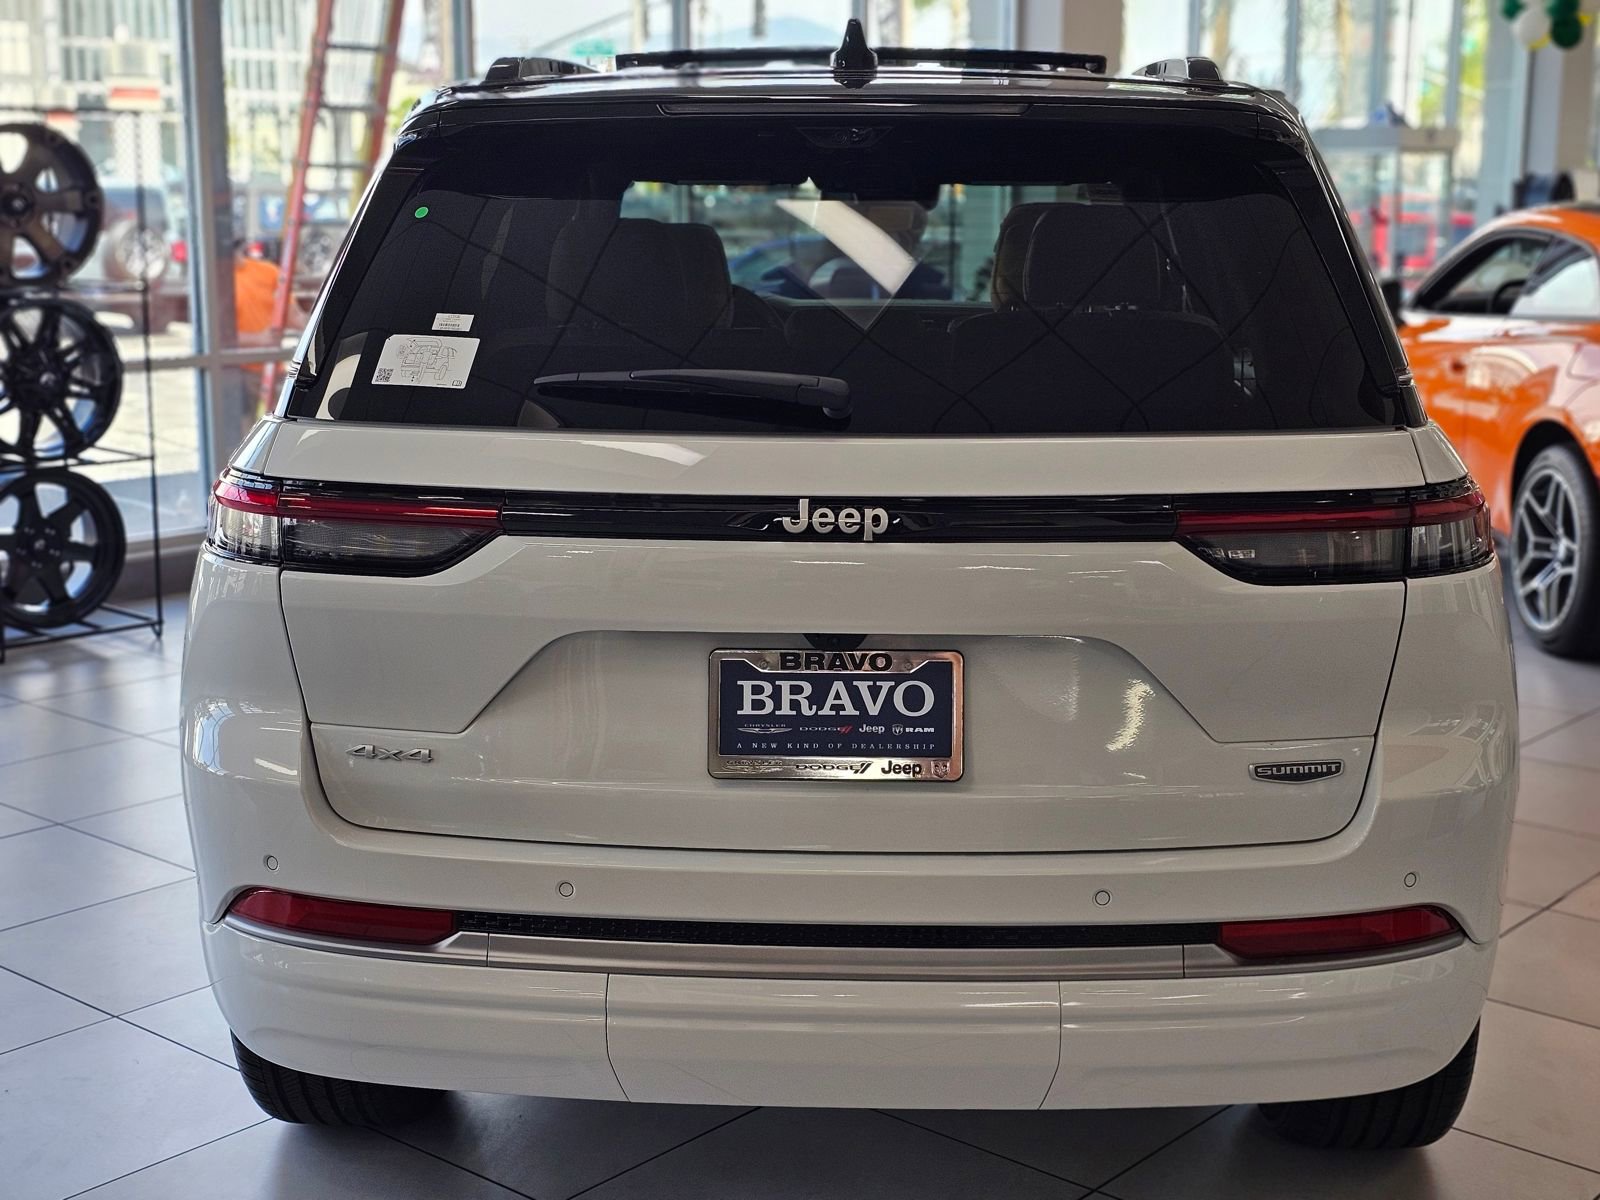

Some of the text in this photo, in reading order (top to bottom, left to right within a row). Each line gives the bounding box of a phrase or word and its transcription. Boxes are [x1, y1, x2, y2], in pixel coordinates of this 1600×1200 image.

[782, 498, 889, 541] Jeep
[780, 652, 893, 672] BRAVO
[737, 680, 935, 717] BRAVO
[859, 724, 885, 734] Jeep
[881, 760, 922, 778] Jeep
[1257, 764, 1340, 776] SUMMIT
